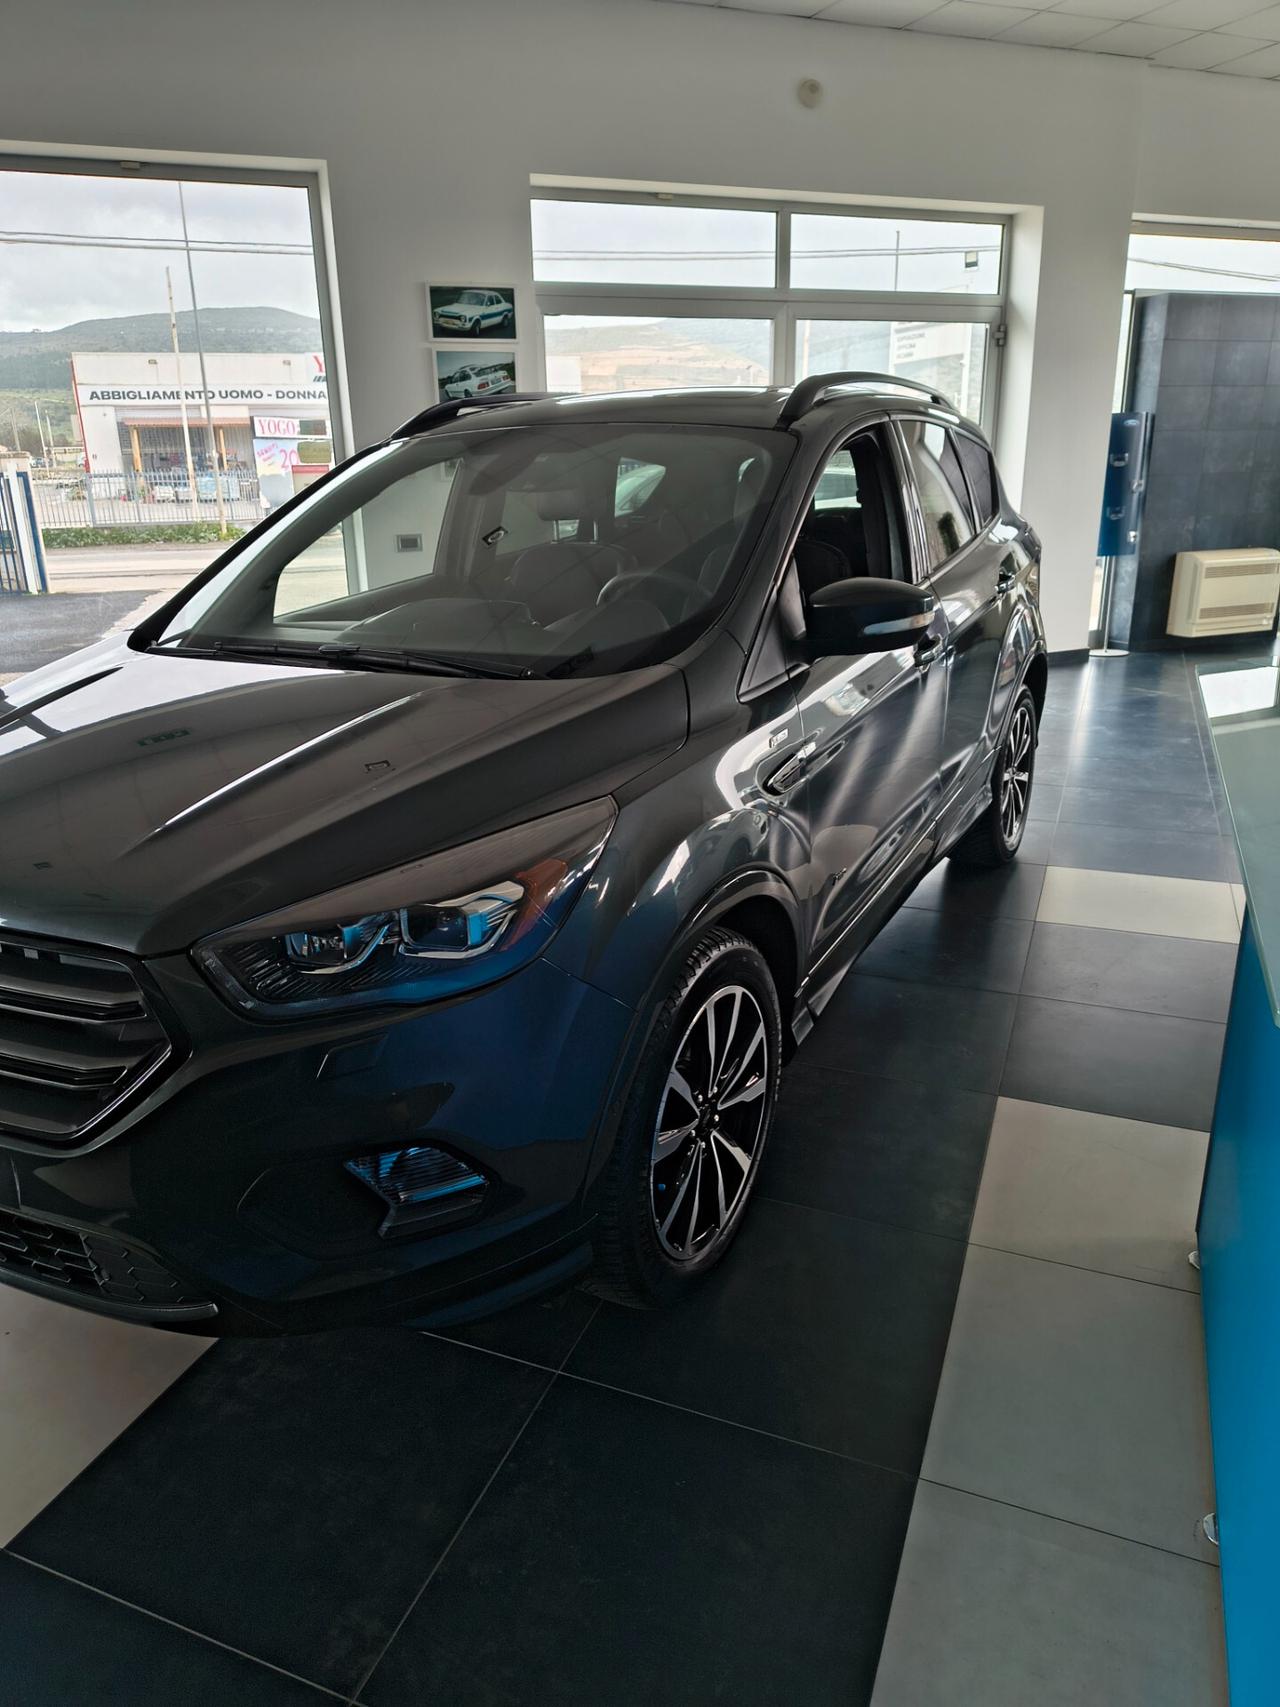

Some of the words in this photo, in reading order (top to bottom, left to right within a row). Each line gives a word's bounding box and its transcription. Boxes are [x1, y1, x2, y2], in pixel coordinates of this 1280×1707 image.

[90, 390, 215, 401] ABBIGLIAMENTO
[218, 388, 264, 400] UOMO
[276, 390, 327, 400] DONNA
[258, 419, 299, 435] YOGO
